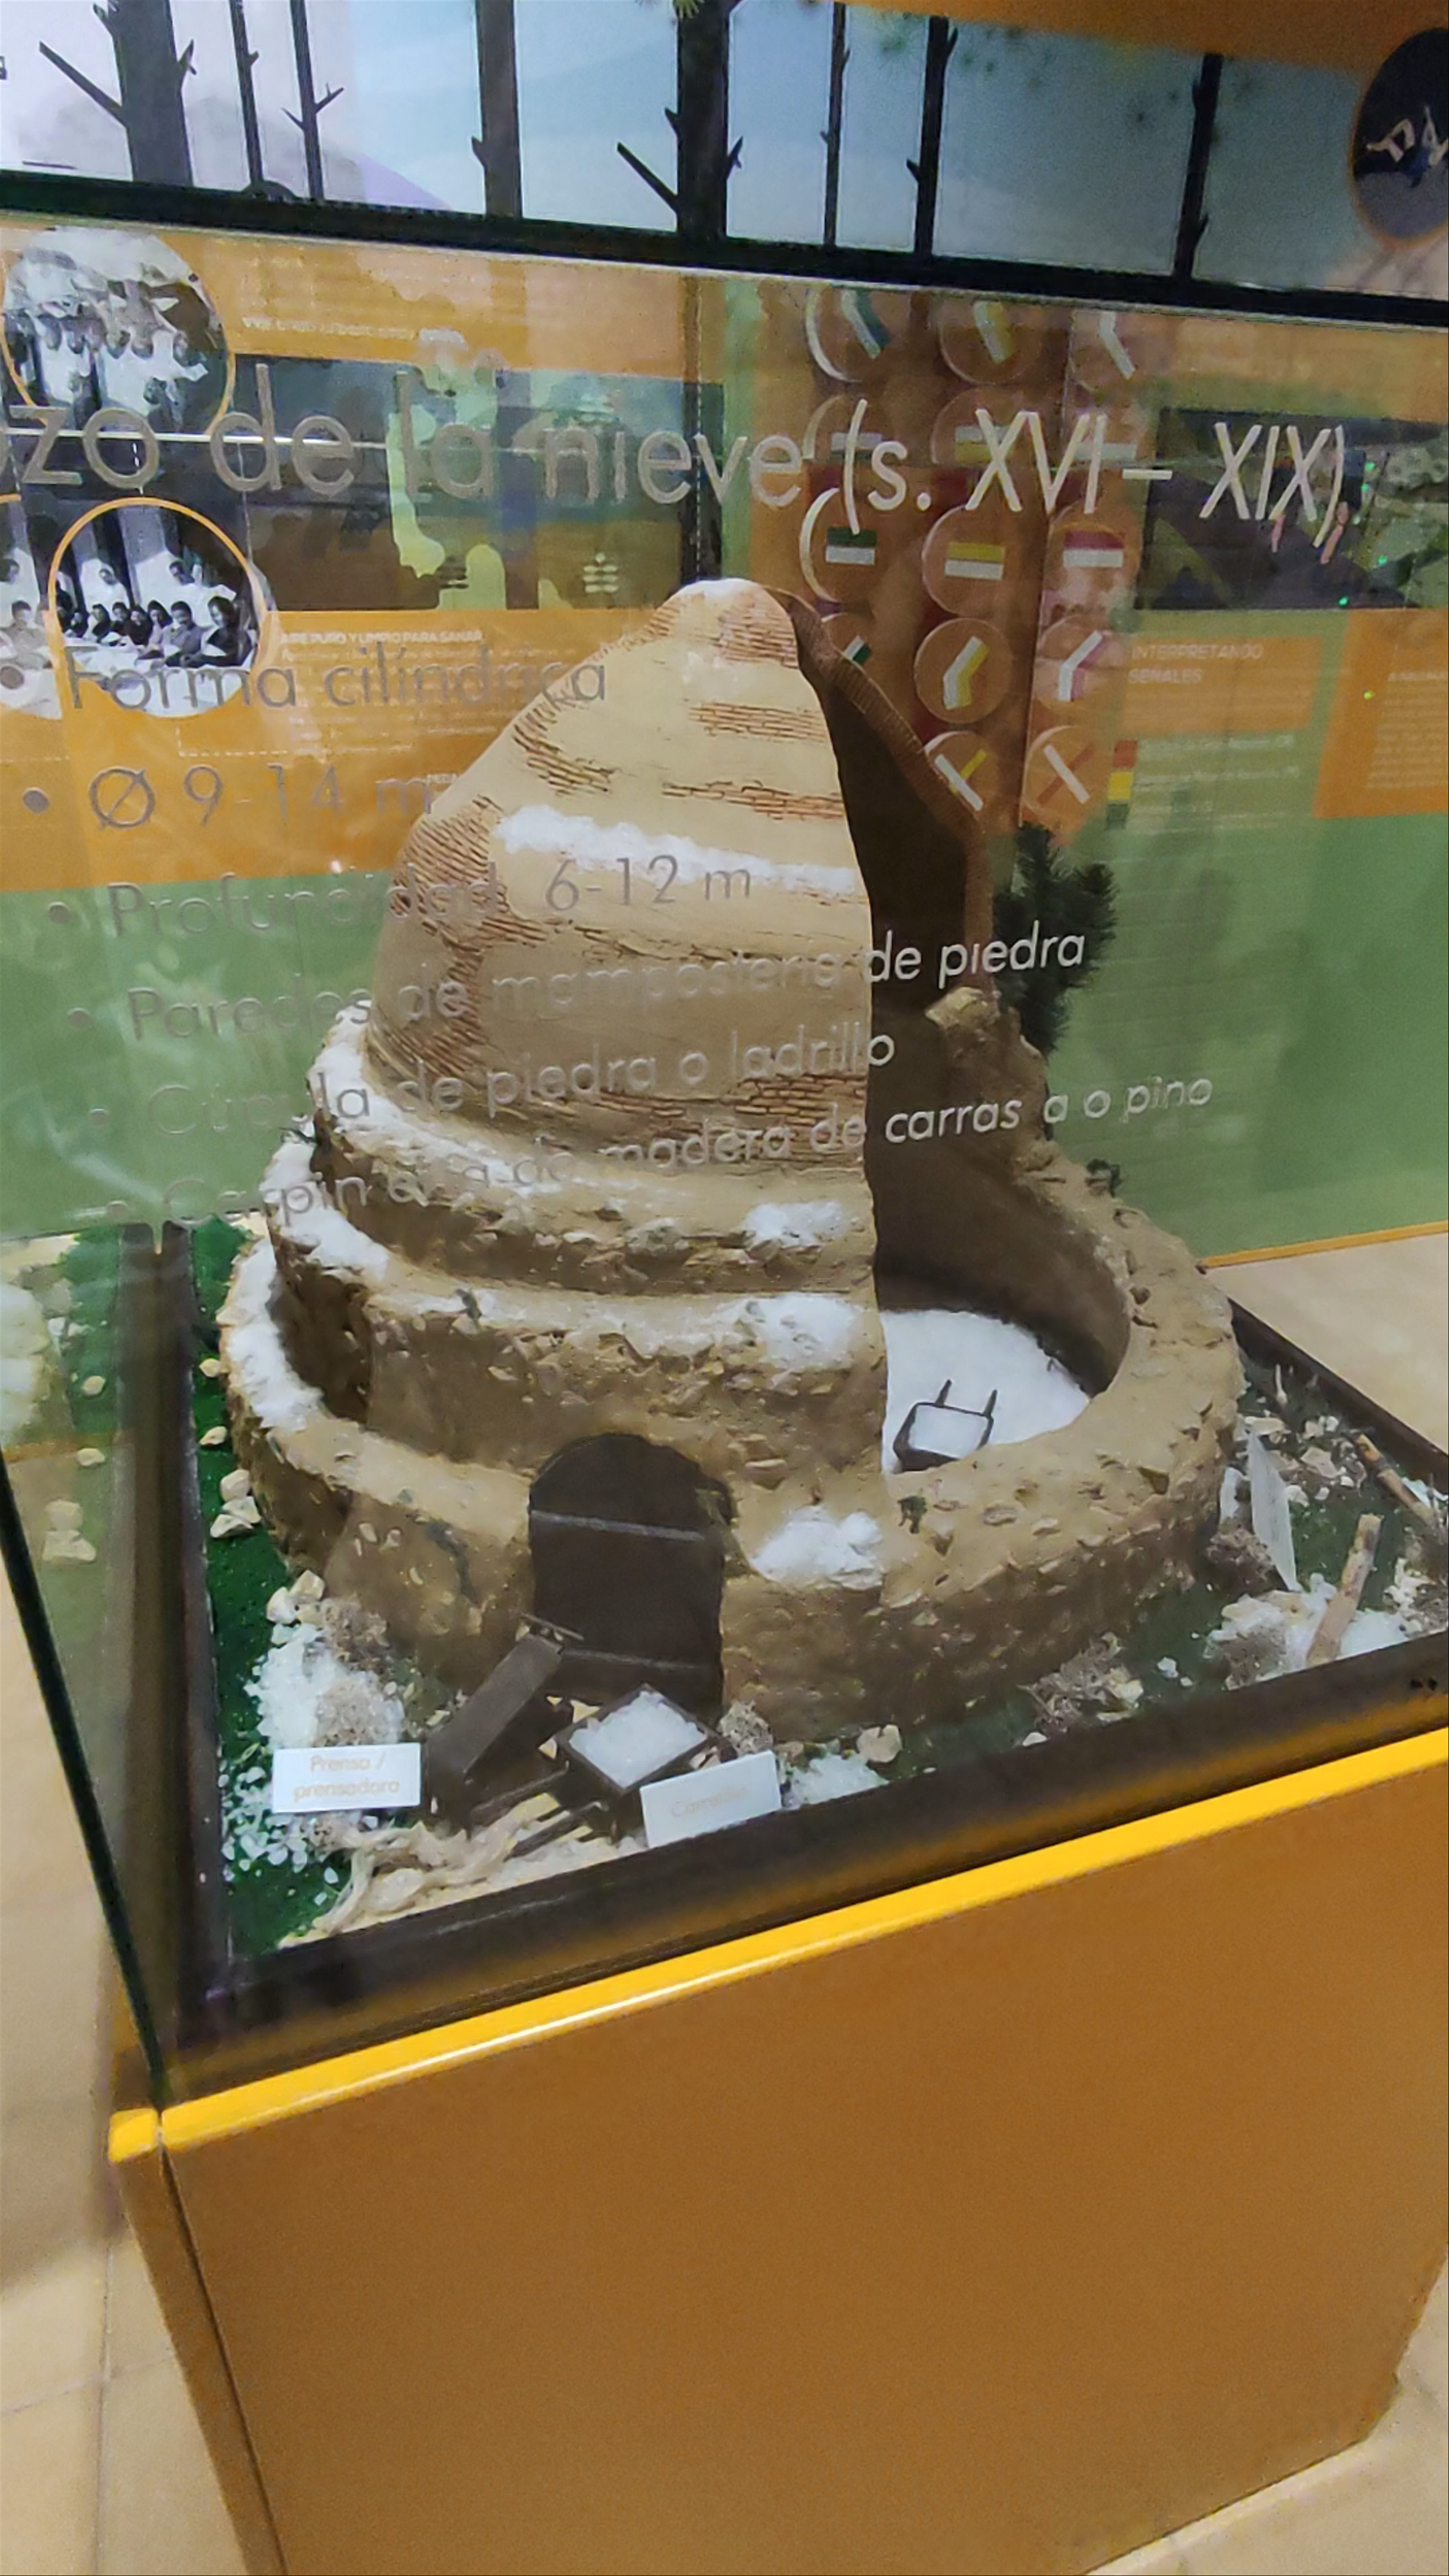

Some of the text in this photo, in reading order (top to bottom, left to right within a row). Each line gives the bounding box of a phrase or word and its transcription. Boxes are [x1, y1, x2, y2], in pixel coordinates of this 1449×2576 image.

[0, 404, 159, 489] zo
[210, 363, 355, 495] de
[397, 370, 493, 500] la
[543, 389, 803, 506] nieve
[844, 398, 932, 534] (s.
[1200, 423, 1345, 548] XIX)
[64, 645, 296, 709] Forma
[545, 854, 678, 912] 6-12
[703, 865, 752, 901] m
[127, 971, 373, 1041] Paredes
[397, 963, 468, 1021] de
[864, 930, 922, 983] de
[938, 920, 1086, 989] piedra
[396, 1057, 465, 1113] de
[487, 1043, 657, 1119] piedra
[680, 1051, 708, 1085] o
[731, 1021, 895, 1079] ladrillo
[810, 1102, 867, 1153] de
[1083, 1089, 1111, 1118] o
[1123, 1076, 1213, 1124] pino
